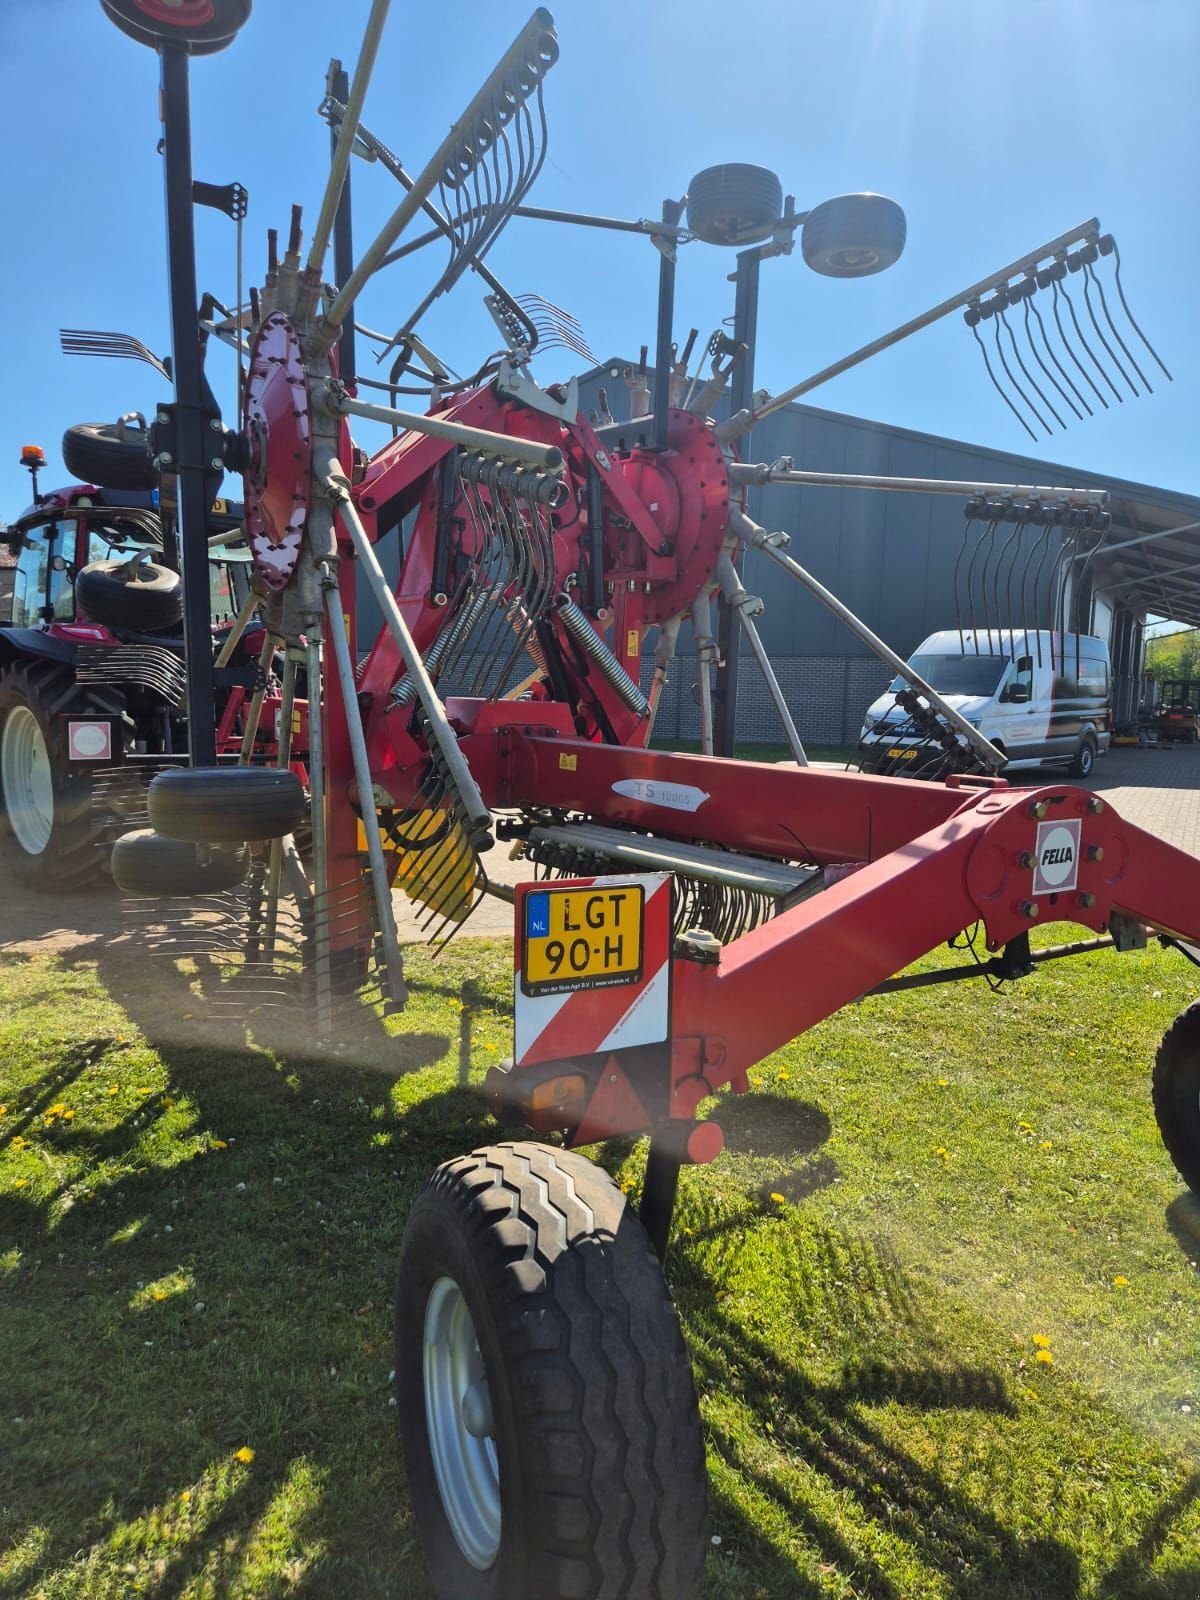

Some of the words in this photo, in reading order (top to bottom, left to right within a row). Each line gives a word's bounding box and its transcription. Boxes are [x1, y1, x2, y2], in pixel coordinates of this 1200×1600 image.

[633, 782, 655, 798] TS
[1041, 847, 1073, 866] FELLA
[564, 894, 626, 932] LGT
[532, 921, 546, 931] NL
[545, 934, 623, 975] 90-H
